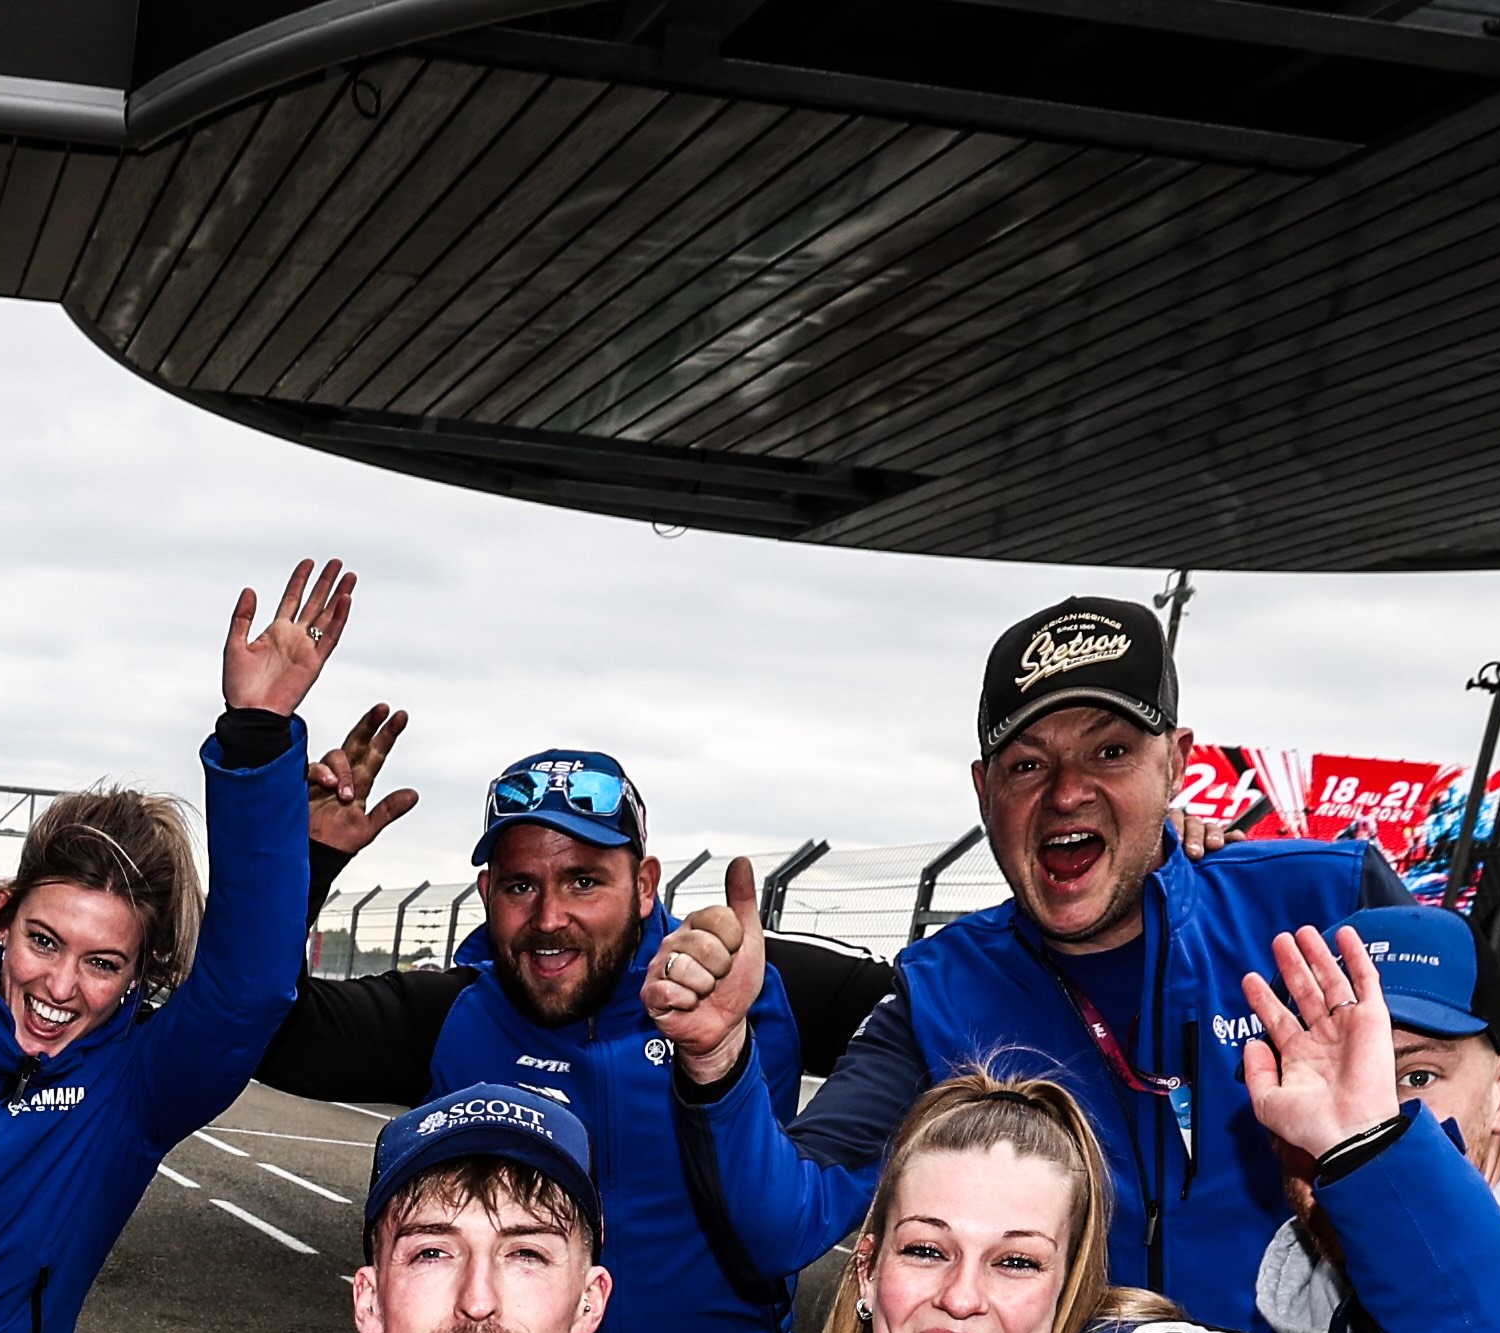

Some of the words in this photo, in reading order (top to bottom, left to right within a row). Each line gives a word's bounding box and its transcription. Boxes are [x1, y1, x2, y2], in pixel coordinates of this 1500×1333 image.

[1032, 613, 1077, 640] AMERICAN
[1014, 631, 1132, 693] Stetson
[530, 760, 584, 772] est
[1319, 775, 1359, 803] 18
[1353, 791, 1381, 805] AU
[1380, 781, 1424, 806] 21
[1314, 801, 1367, 819] AVRIL
[1368, 805, 1415, 822] 2024
[1370, 953, 1440, 966] EERING
[1226, 1014, 1268, 1039] YAM
[516, 1055, 571, 1073] GYTR
[30, 1087, 85, 1106] AMAHA
[448, 1099, 545, 1125] SCOTT
